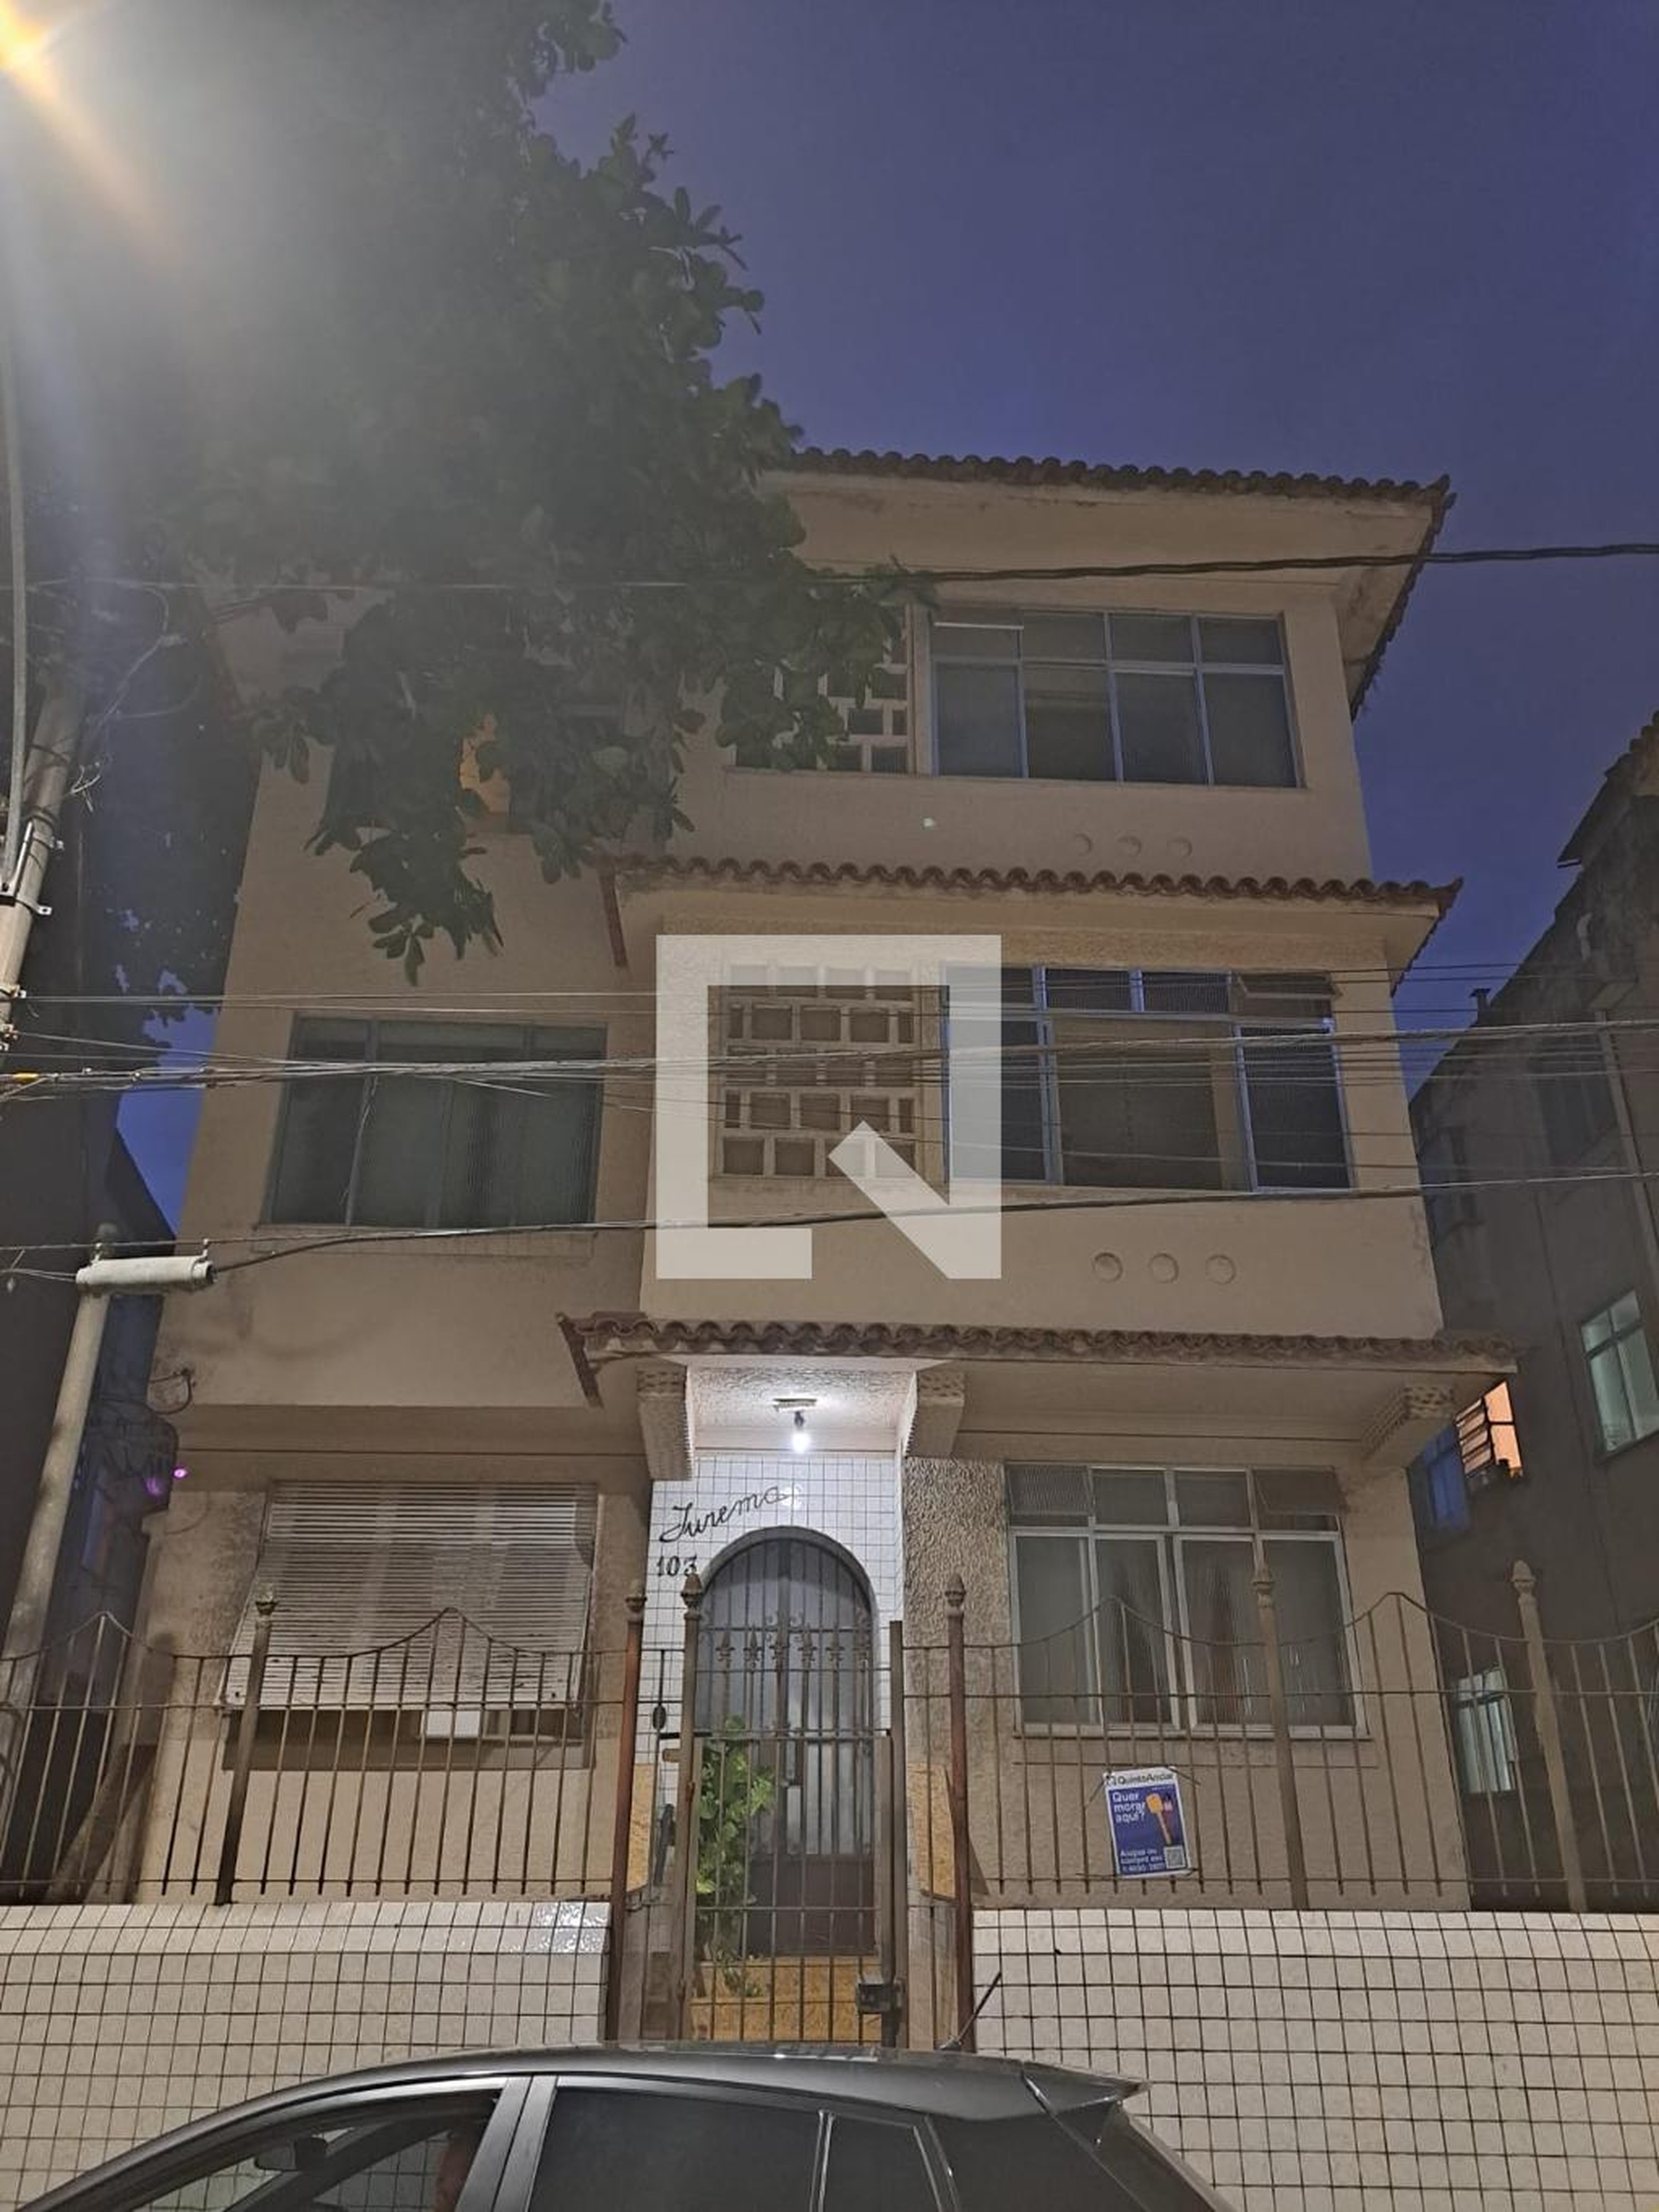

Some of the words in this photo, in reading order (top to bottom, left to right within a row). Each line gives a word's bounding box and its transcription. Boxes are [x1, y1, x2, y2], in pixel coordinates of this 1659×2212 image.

[657, 1555, 698, 1577] 103
[1112, 1792, 1138, 1802] Quer
[1114, 1801, 1145, 1813] morar
[1115, 1811, 1145, 1824] aqui?
